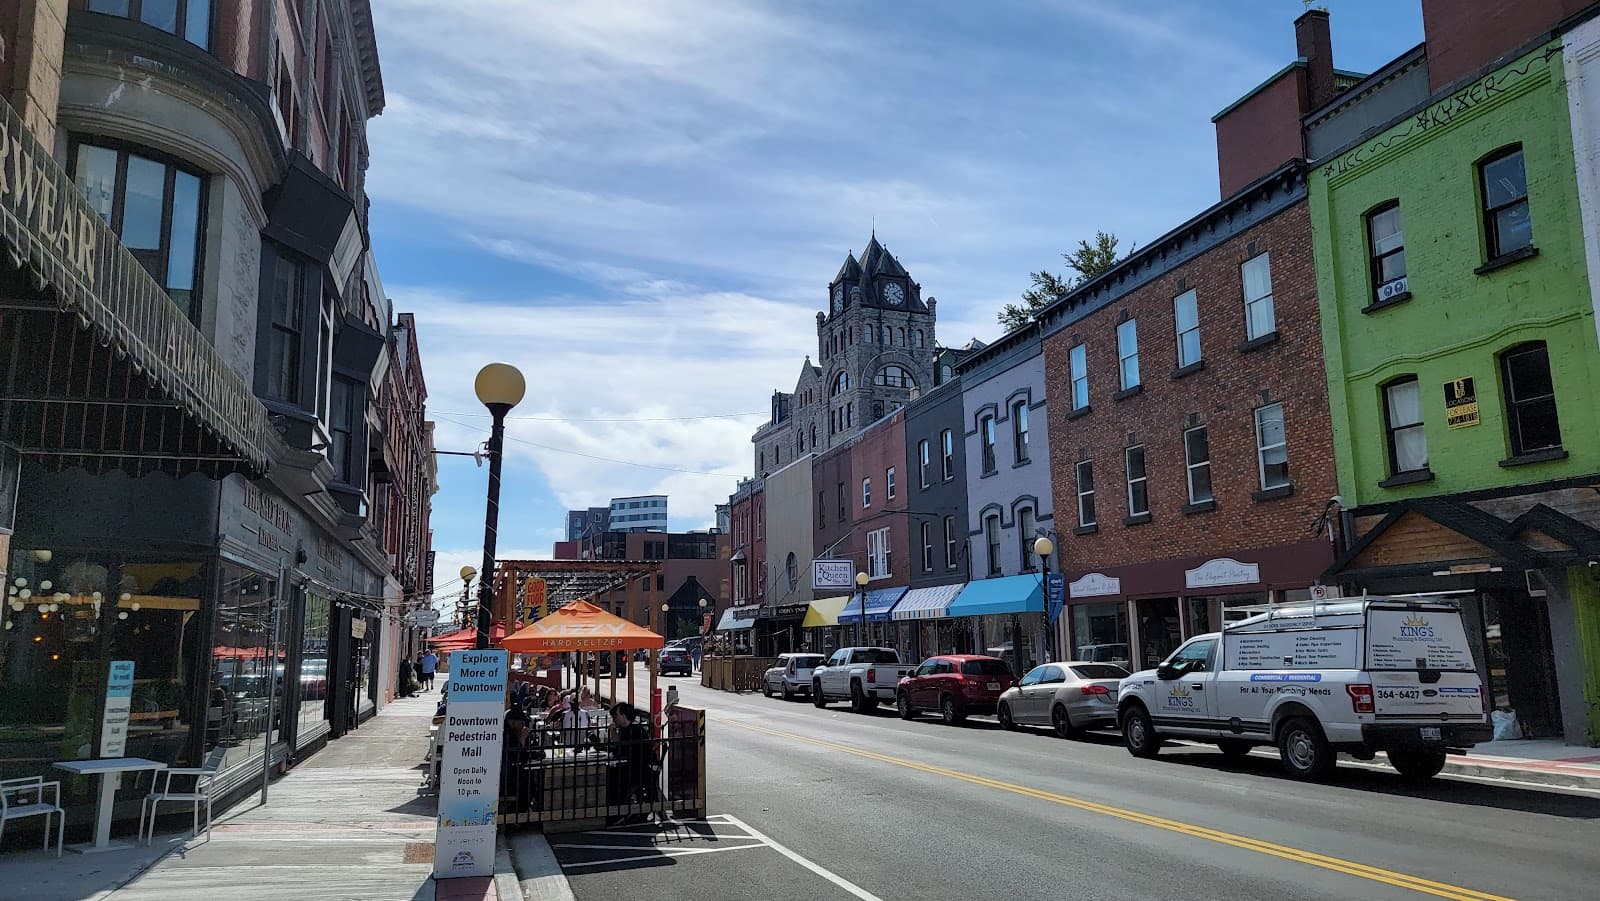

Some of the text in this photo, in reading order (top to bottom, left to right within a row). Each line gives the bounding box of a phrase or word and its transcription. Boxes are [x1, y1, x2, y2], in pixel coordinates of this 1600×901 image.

[819, 564, 848, 573] Kitchen
[823, 571, 848, 581] Queen
[528, 581, 544, 593] GOOD
[535, 623, 626, 635] VIZZY
[1399, 626, 1434, 637] KING'S
[542, 638, 624, 647] HARD SELTZER
[462, 653, 499, 665] Explore
[460, 667, 499, 678] More of
[453, 682, 503, 692] Downtown
[1262, 686, 1274, 694] Your
[1277, 687, 1307, 696] Plumbing
[1308, 687, 1331, 695] Needs
[1377, 690, 1420, 699] 364-6427
[449, 716, 498, 726] Downtown
[448, 731, 497, 741] Pedestrian
[461, 747, 482, 757] Mall
[453, 766, 487, 776] Open Daily
[457, 788, 481, 797] 10 p.m.
